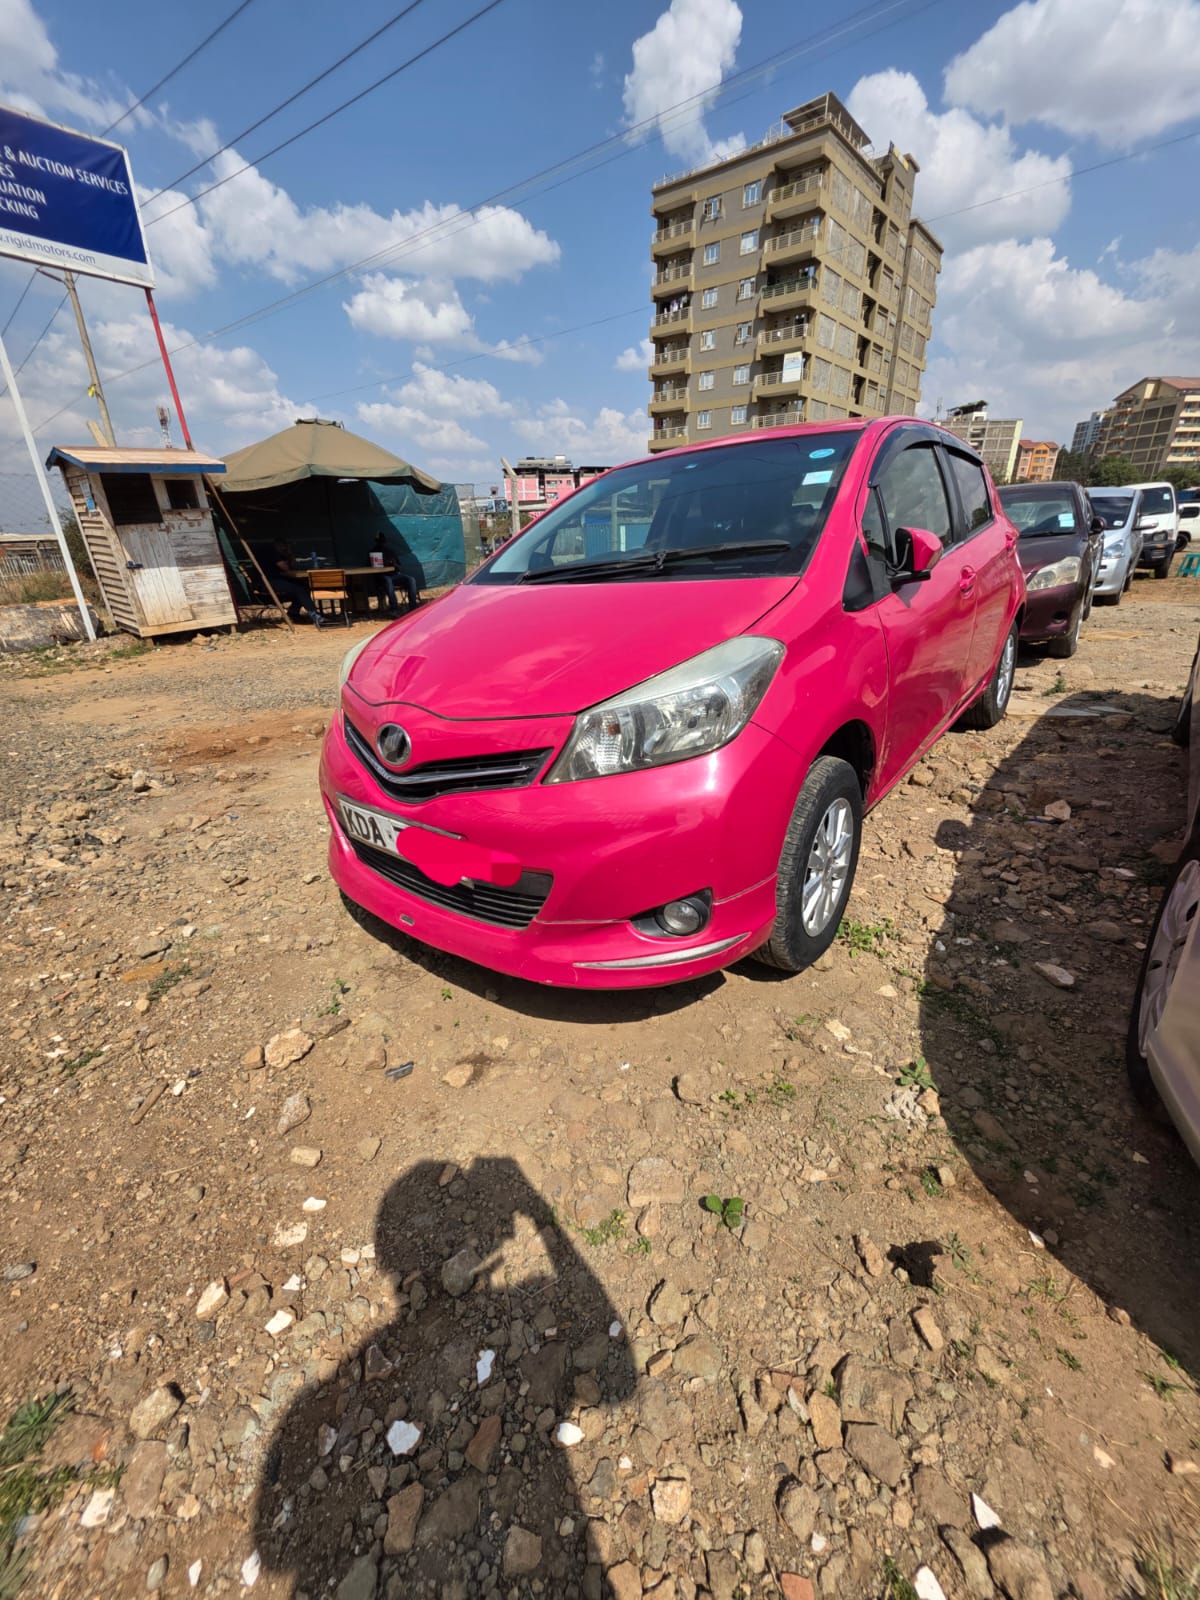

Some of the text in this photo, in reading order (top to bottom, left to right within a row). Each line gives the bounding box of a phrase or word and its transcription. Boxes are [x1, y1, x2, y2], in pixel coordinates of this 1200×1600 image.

[4, 145, 128, 195] & AUCTION SERVICES
[343, 806, 387, 848] KDA
